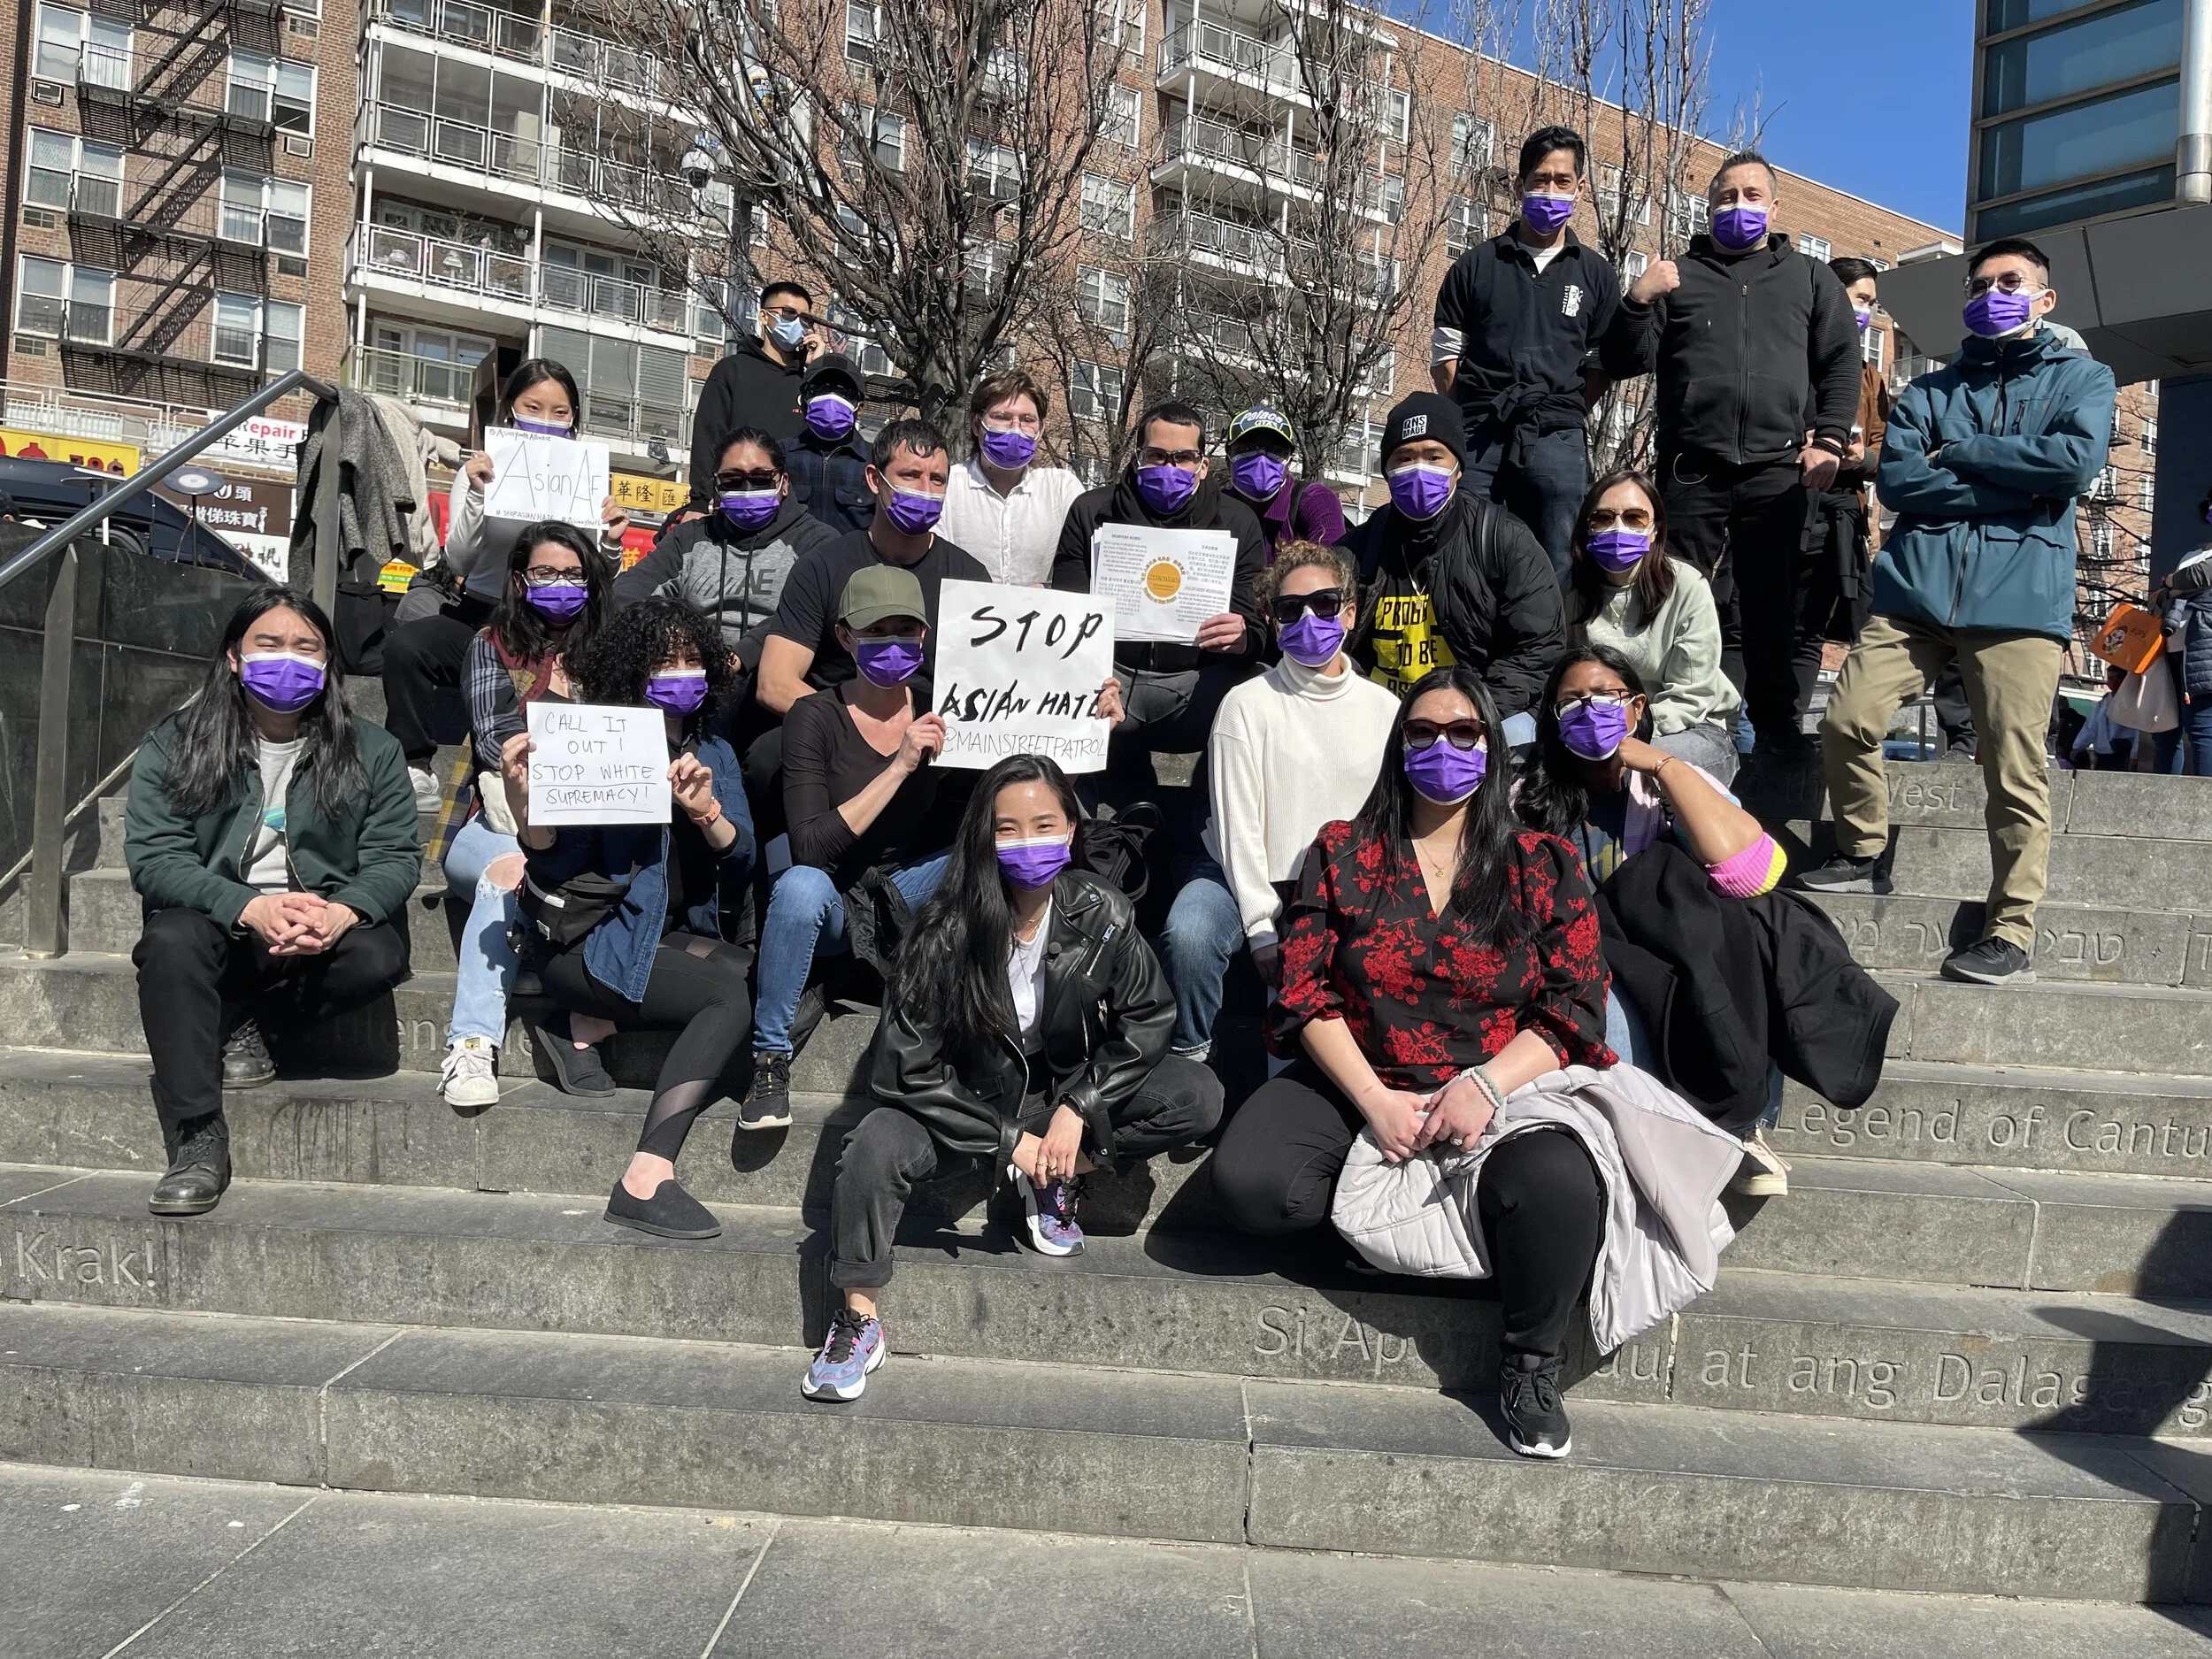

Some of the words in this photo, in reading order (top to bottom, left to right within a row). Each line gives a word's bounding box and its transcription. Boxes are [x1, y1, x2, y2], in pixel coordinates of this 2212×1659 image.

[1402, 425, 1425, 439] MADE
[971, 605, 1103, 661] STOP
[1396, 642, 1413, 666] TO
[1419, 640, 1439, 664] BE
[938, 679, 1031, 723] ASIAN
[1036, 687, 1107, 720] HATE
[545, 711, 588, 733] CALL
[603, 716, 626, 733] IT
[941, 726, 1106, 758] @MAINSTREETPATROL
[533, 764, 585, 781] STOP
[600, 764, 655, 780] WHITE
[546, 786, 648, 807] SUPREMACY!
[1773, 1099, 1961, 1148] Legend
[1988, 1104, 2046, 1148] of
[15, 1229, 157, 1288] Krak!
[1254, 1305, 1307, 1358] Si
[1701, 1342, 1758, 1389] at
[1787, 1355, 1903, 1409] ang
